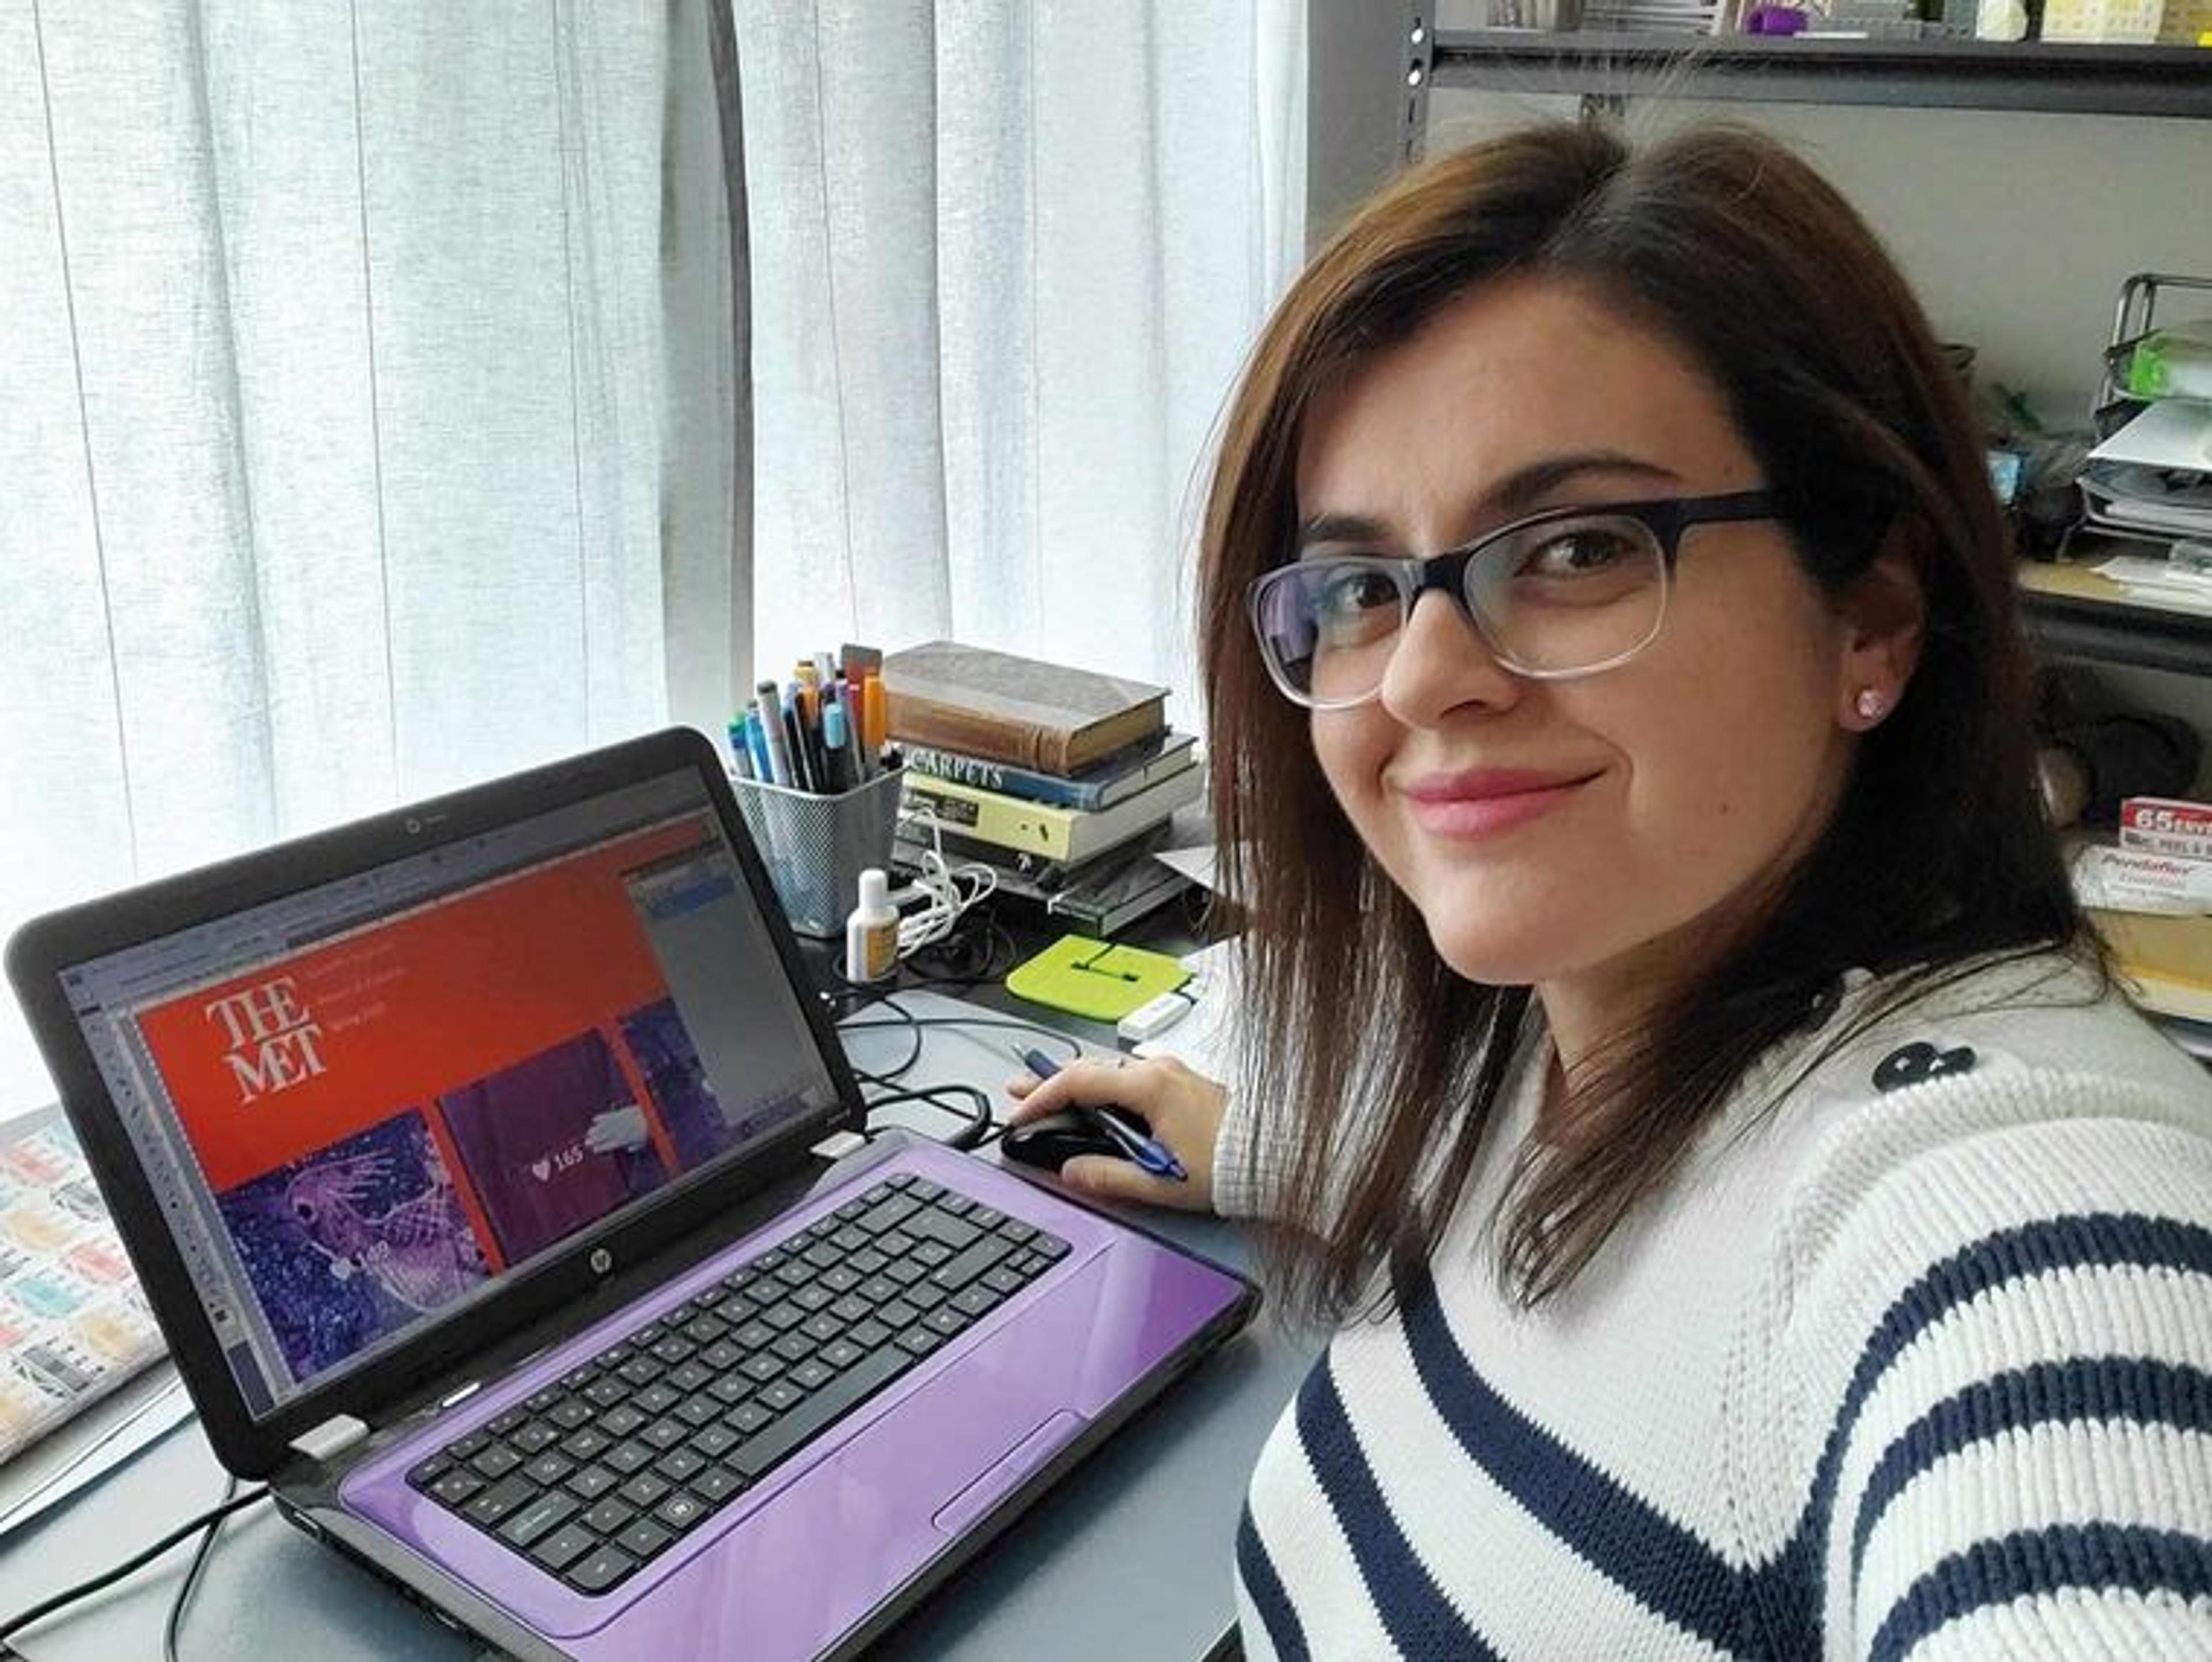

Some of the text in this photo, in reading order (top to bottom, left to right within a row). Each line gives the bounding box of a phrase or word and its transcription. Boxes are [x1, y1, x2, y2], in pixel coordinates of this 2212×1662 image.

[910, 749, 1003, 789] CARPETS
[205, 976, 310, 1048] THE
[222, 1024, 327, 1104] MET
